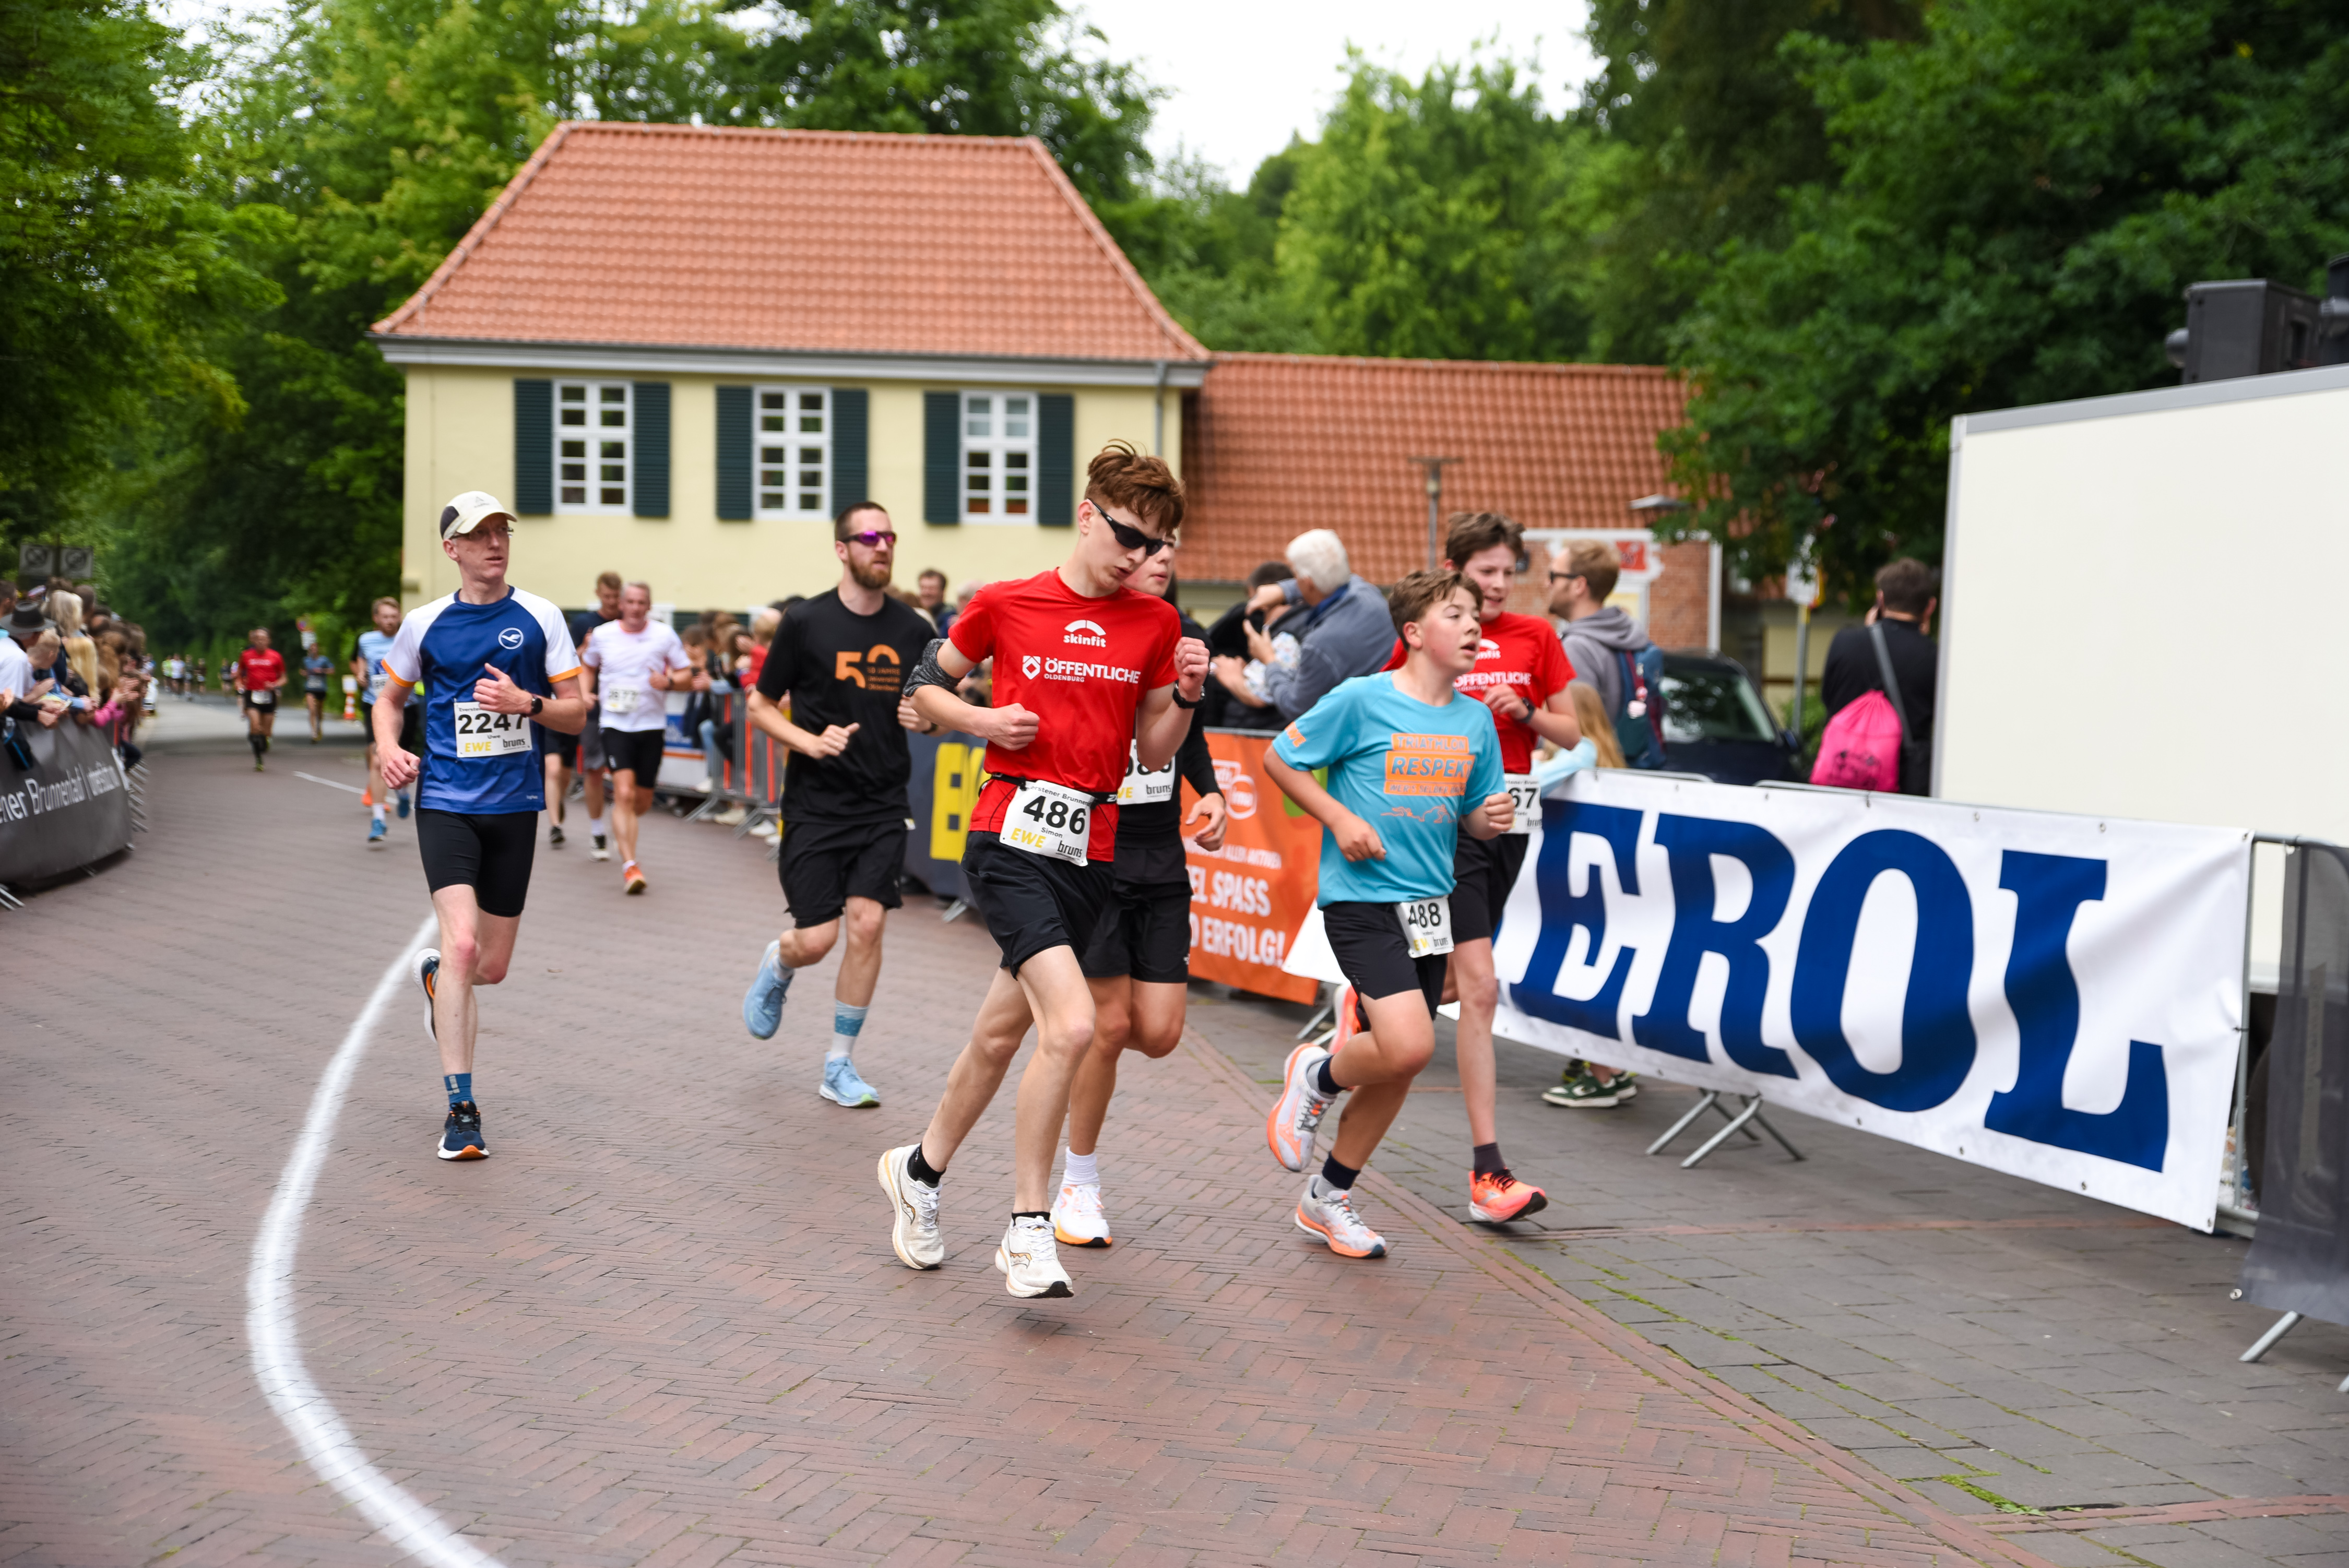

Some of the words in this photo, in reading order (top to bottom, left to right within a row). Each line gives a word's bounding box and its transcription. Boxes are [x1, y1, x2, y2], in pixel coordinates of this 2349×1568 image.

[1063, 633, 1106, 648] skinfit
[835, 644, 900, 689] 50
[1044, 673, 1085, 683] OLDENBURG
[1045, 657, 1142, 684] ÖFFENTLICHE
[458, 713, 524, 734] 2247
[465, 741, 492, 752] EWE
[503, 739, 526, 748] bruns
[1397, 737, 1466, 751] TRIATHLON
[1146, 784, 1171, 795] bruns
[1023, 795, 1086, 835] 486
[1011, 828, 1047, 849] EWE
[1057, 840, 1083, 858] bruns
[1041, 827, 1063, 838] Simon
[1185, 864, 1208, 905] EL
[1210, 869, 1272, 918] SPASS
[1408, 902, 1442, 929] 488
[1202, 915, 1286, 969] ERFOLG!
[1493, 799, 2168, 1174] EROL
